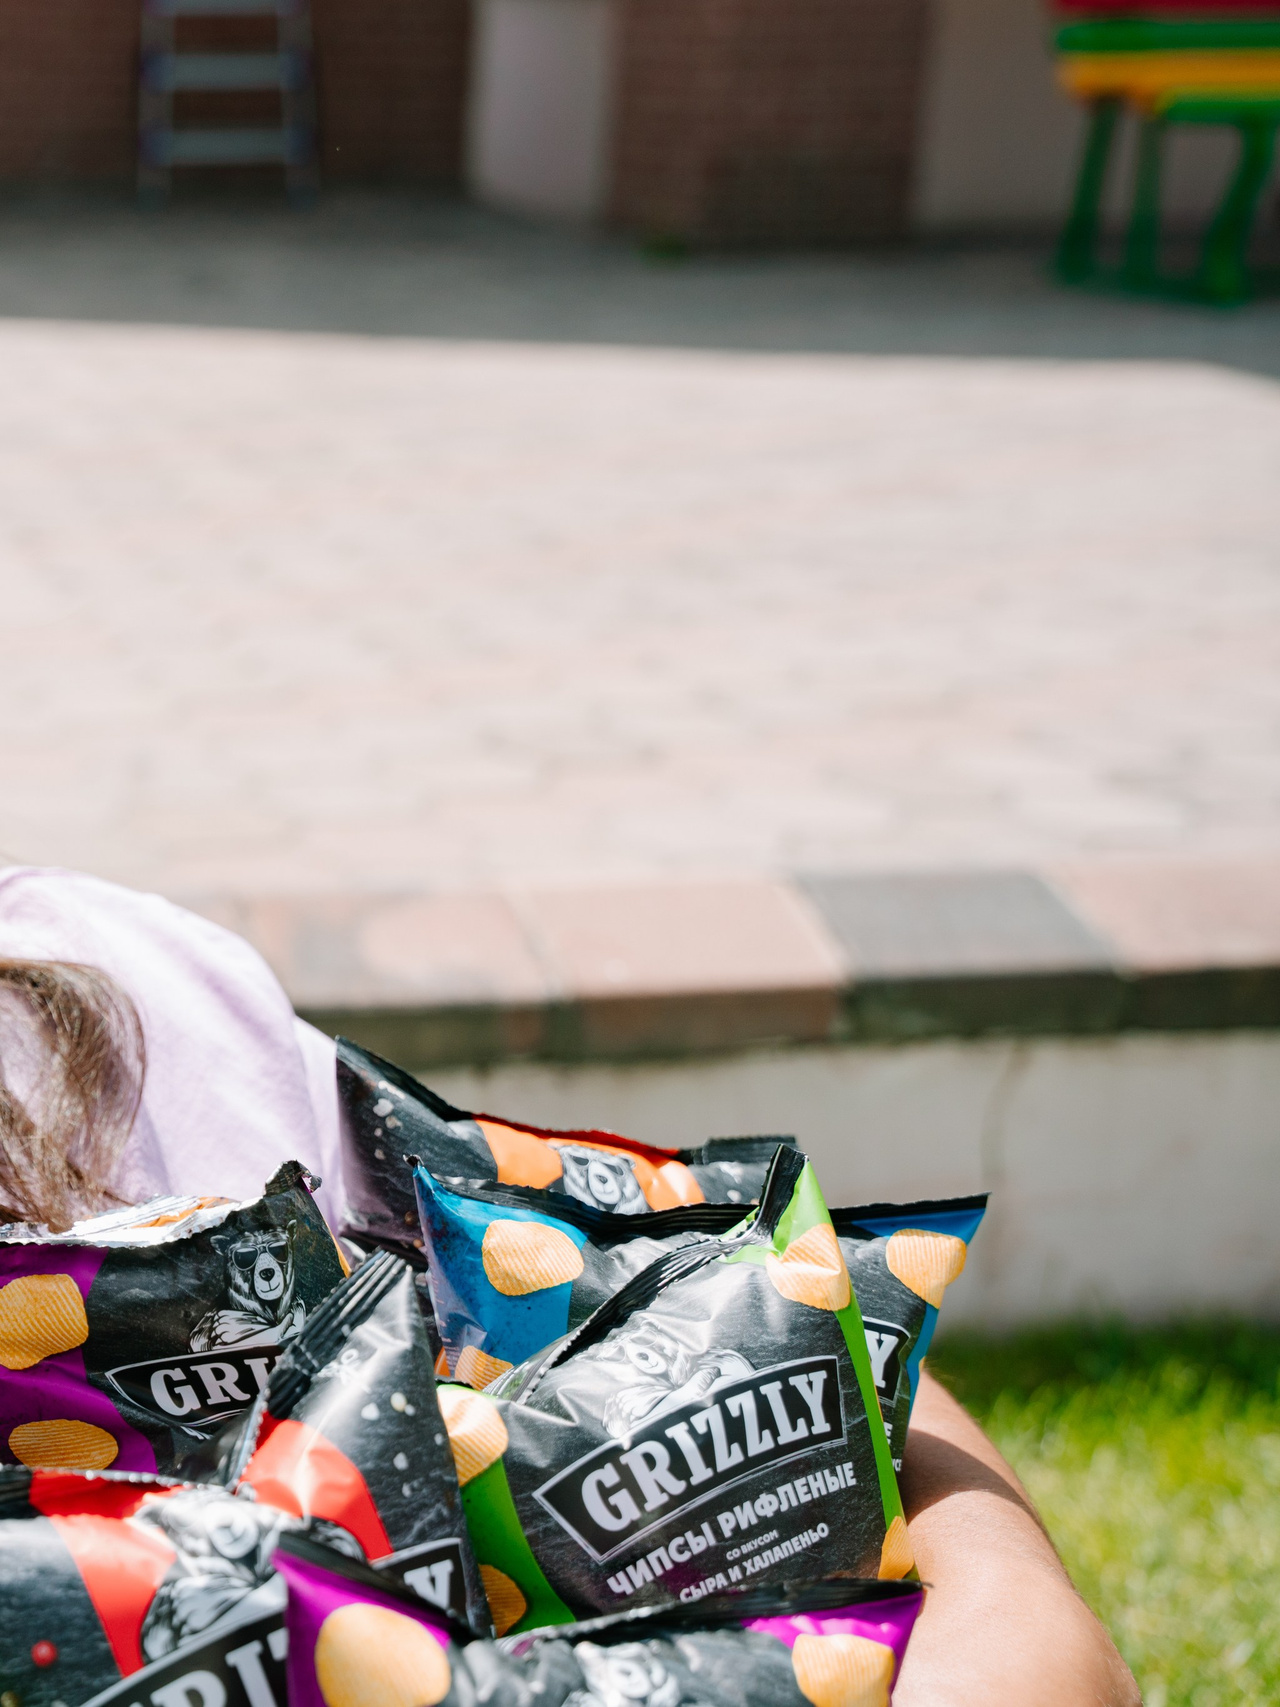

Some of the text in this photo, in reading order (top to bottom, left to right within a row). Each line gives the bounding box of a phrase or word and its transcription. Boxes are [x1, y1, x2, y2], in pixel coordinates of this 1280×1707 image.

[150, 1356, 281, 1416] GRI
[581, 1370, 831, 1532] GRIZZLY
[606, 1462, 857, 1596] ЧИПСЫ РИФЛЕНЫЕ
[679, 1522, 830, 1603] СЫРА И ХАЛАПЕНЬО
[725, 1529, 779, 1561] СО ВКУСОМ
